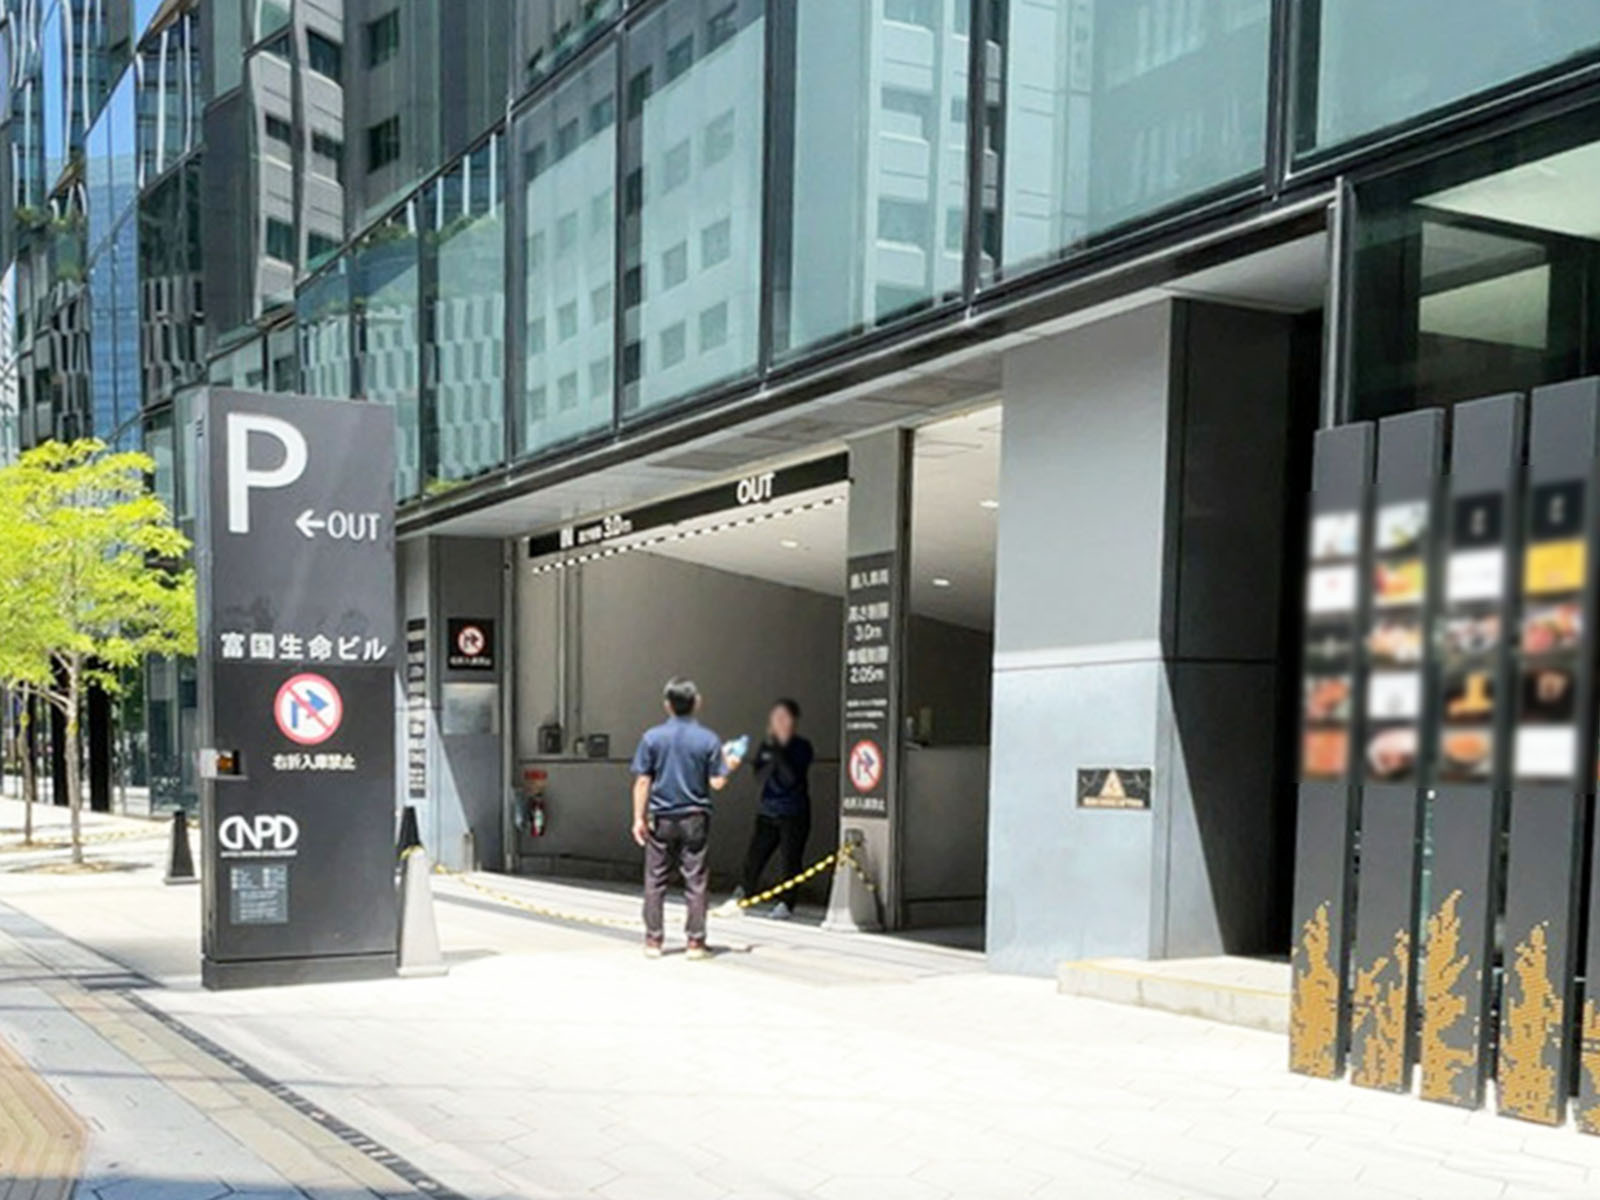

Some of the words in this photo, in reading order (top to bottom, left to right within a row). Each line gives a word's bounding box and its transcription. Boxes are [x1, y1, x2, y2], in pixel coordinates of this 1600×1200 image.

[227, 412, 308, 534] P
[737, 472, 775, 504] OUT
[327, 510, 381, 541] OUT
[220, 631, 388, 661] 富国生命ビル
